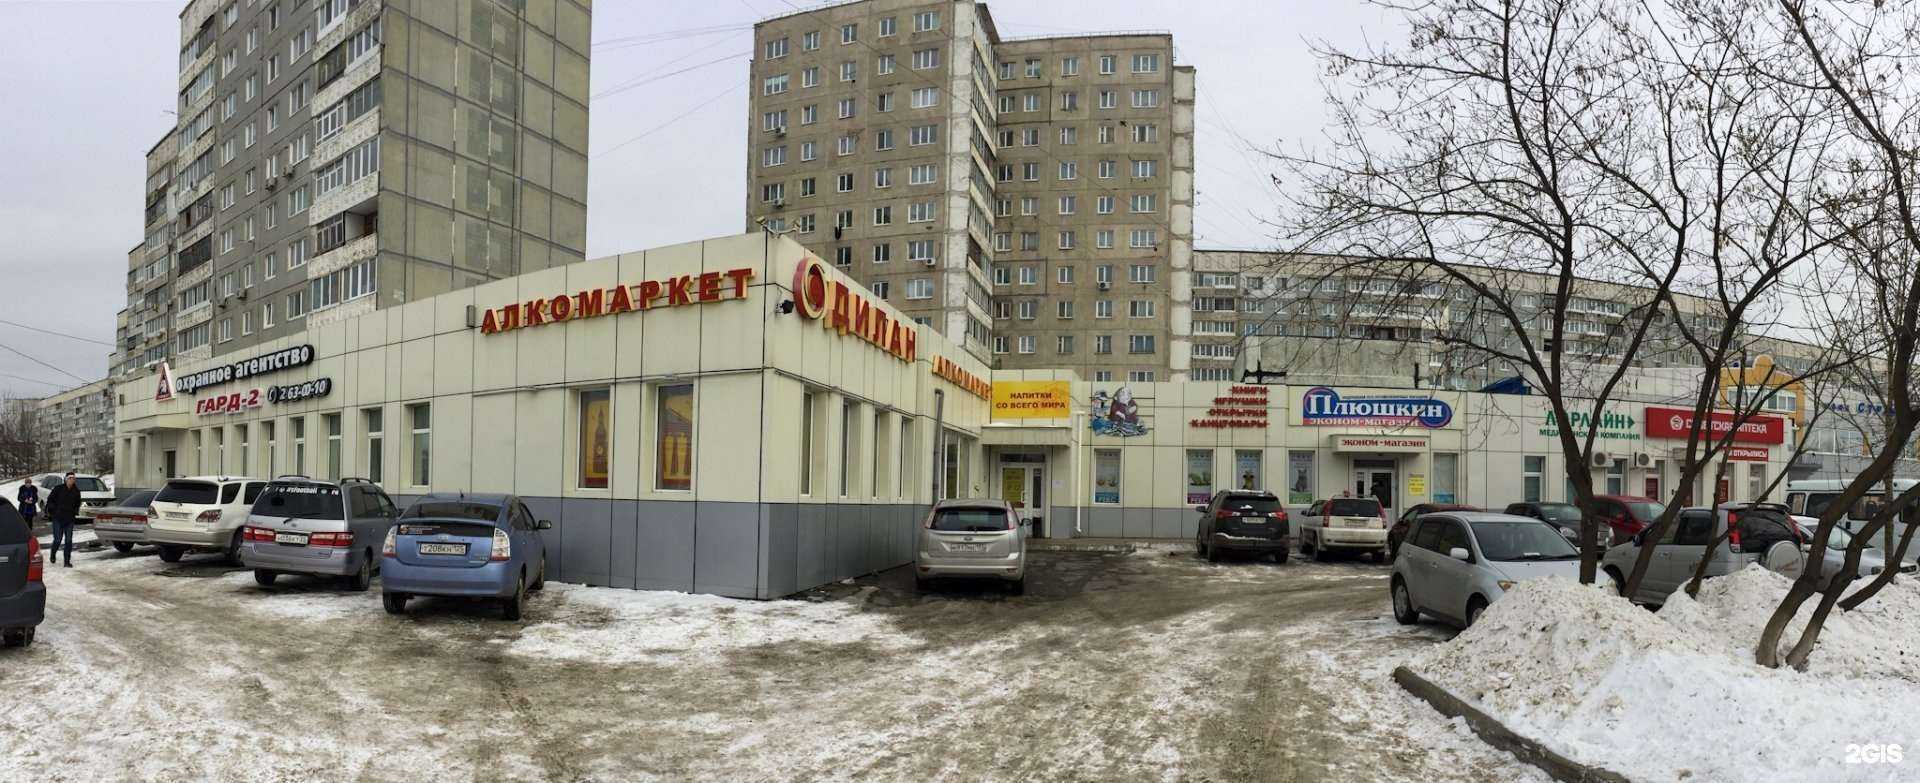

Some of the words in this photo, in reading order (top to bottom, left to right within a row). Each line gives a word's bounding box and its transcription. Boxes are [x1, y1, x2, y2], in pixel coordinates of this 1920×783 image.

[481, 268, 754, 335] АЛКОМАРКЕТ
[828, 280, 916, 363] ДИЛАН
[176, 365, 231, 392] охранное
[235, 346, 310, 378] агентство
[1231, 386, 1268, 395] КНИГИ
[1009, 392, 1052, 400] НАПИТКИ
[196, 389, 260, 414] ГАРД-2
[995, 402, 1008, 410] СО
[1010, 402, 1039, 410] ВСЕГО
[1040, 402, 1066, 410] МИРА
[1214, 397, 1268, 406] ИГРУШКИ
[1308, 394, 1443, 418] Плюшкин
[1208, 408, 1268, 417] ОТКРЫТКИ
[1190, 419, 1268, 429] КАНЦТОВАРЫ
[1545, 410, 1625, 429] АРЛЙН
[1600, 431, 1641, 440] КОМПАНИЯ
